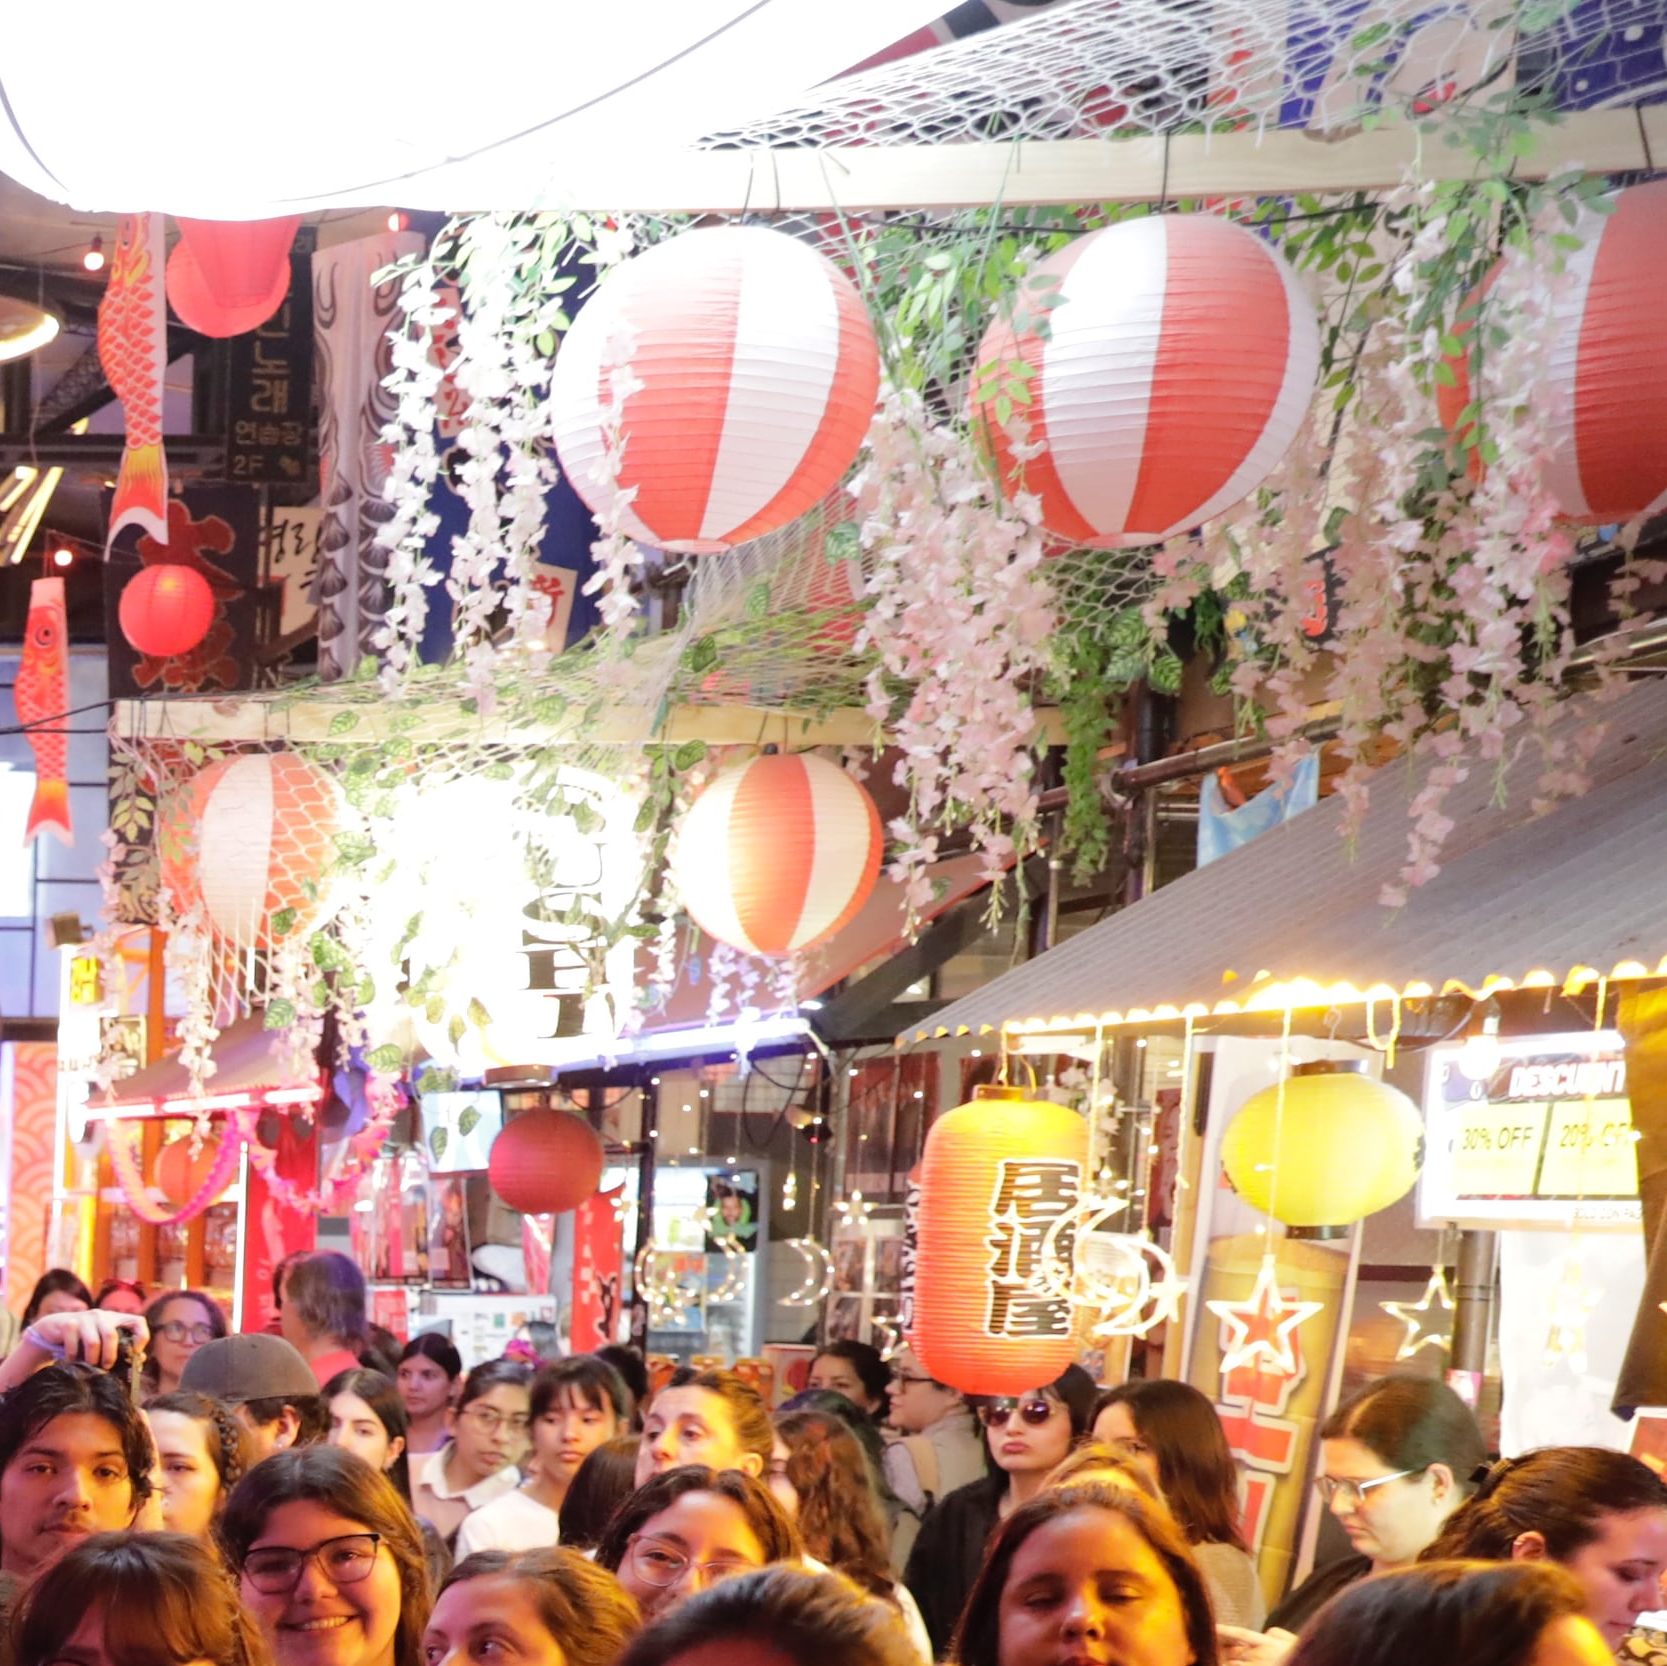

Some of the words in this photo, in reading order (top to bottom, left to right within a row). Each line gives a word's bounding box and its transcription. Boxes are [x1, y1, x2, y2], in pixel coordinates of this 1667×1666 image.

[233, 454, 265, 475] 2F
[1462, 1127, 1492, 1150] 30%
[1497, 1126, 1534, 1150] OFF
